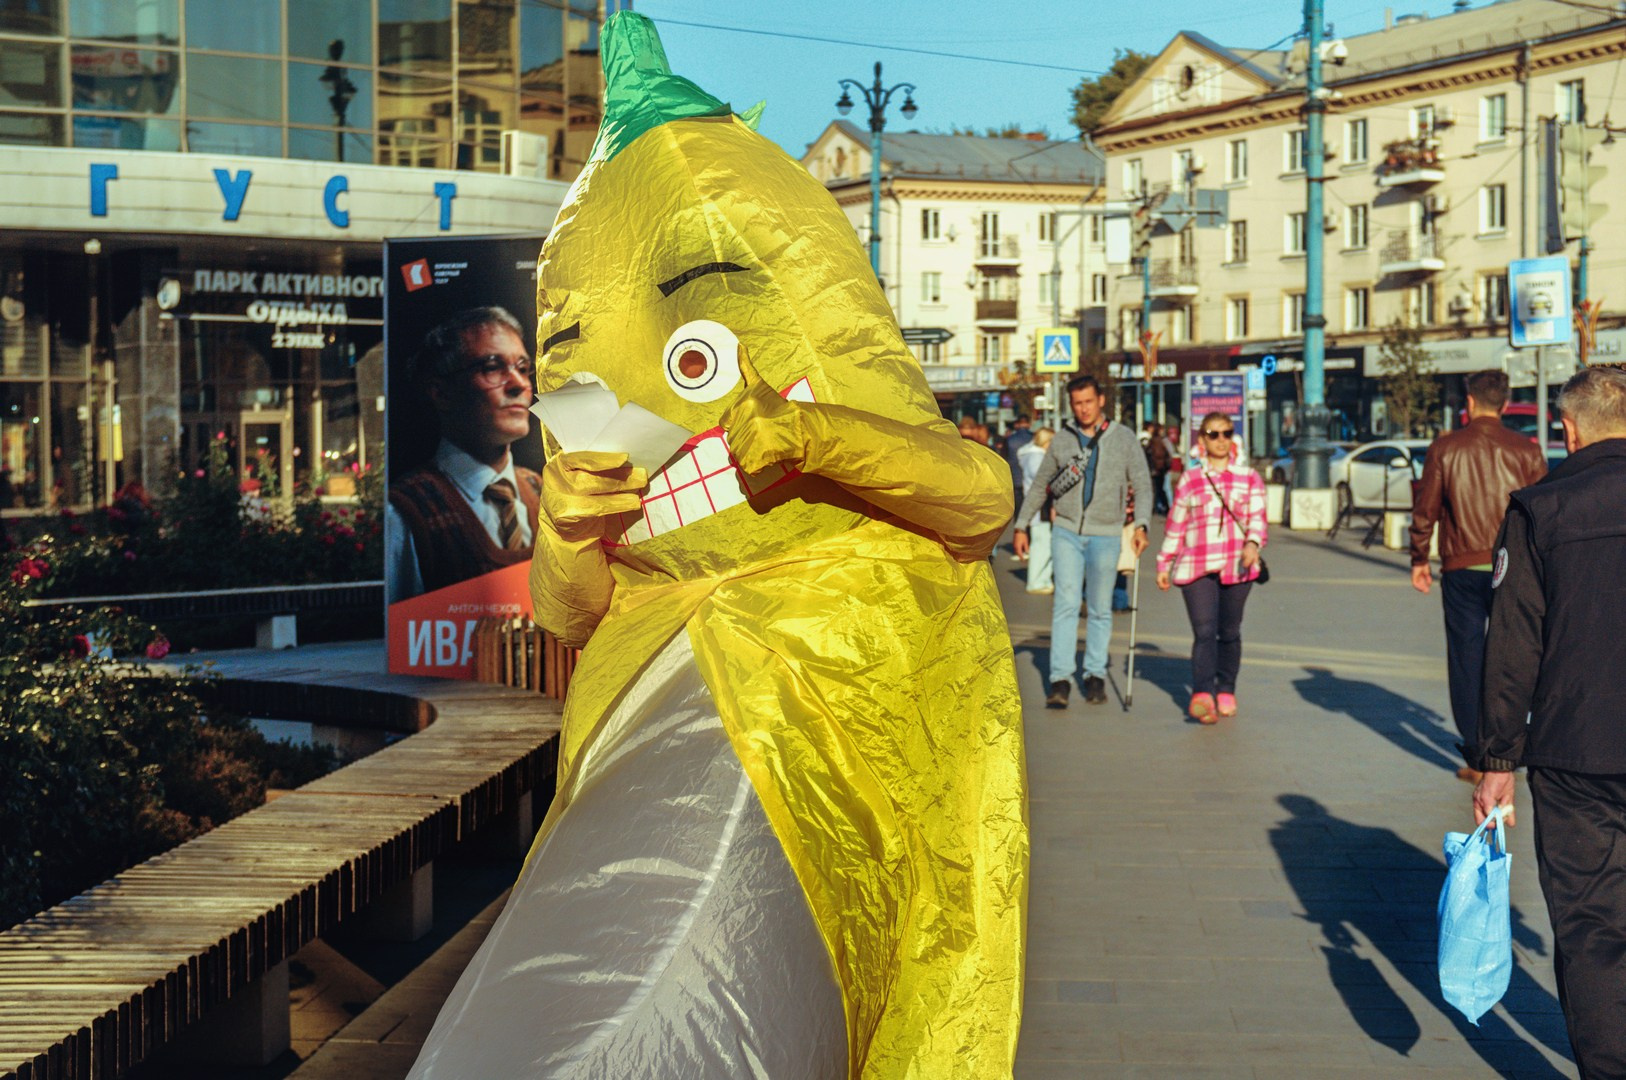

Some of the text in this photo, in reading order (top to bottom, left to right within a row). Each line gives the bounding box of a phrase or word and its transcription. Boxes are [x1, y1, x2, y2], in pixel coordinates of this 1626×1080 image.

[195, 270, 257, 293] ПАРК
[271, 333, 285, 348] 2
[448, 603, 522, 613] АНТОН ЧЕХОВ
